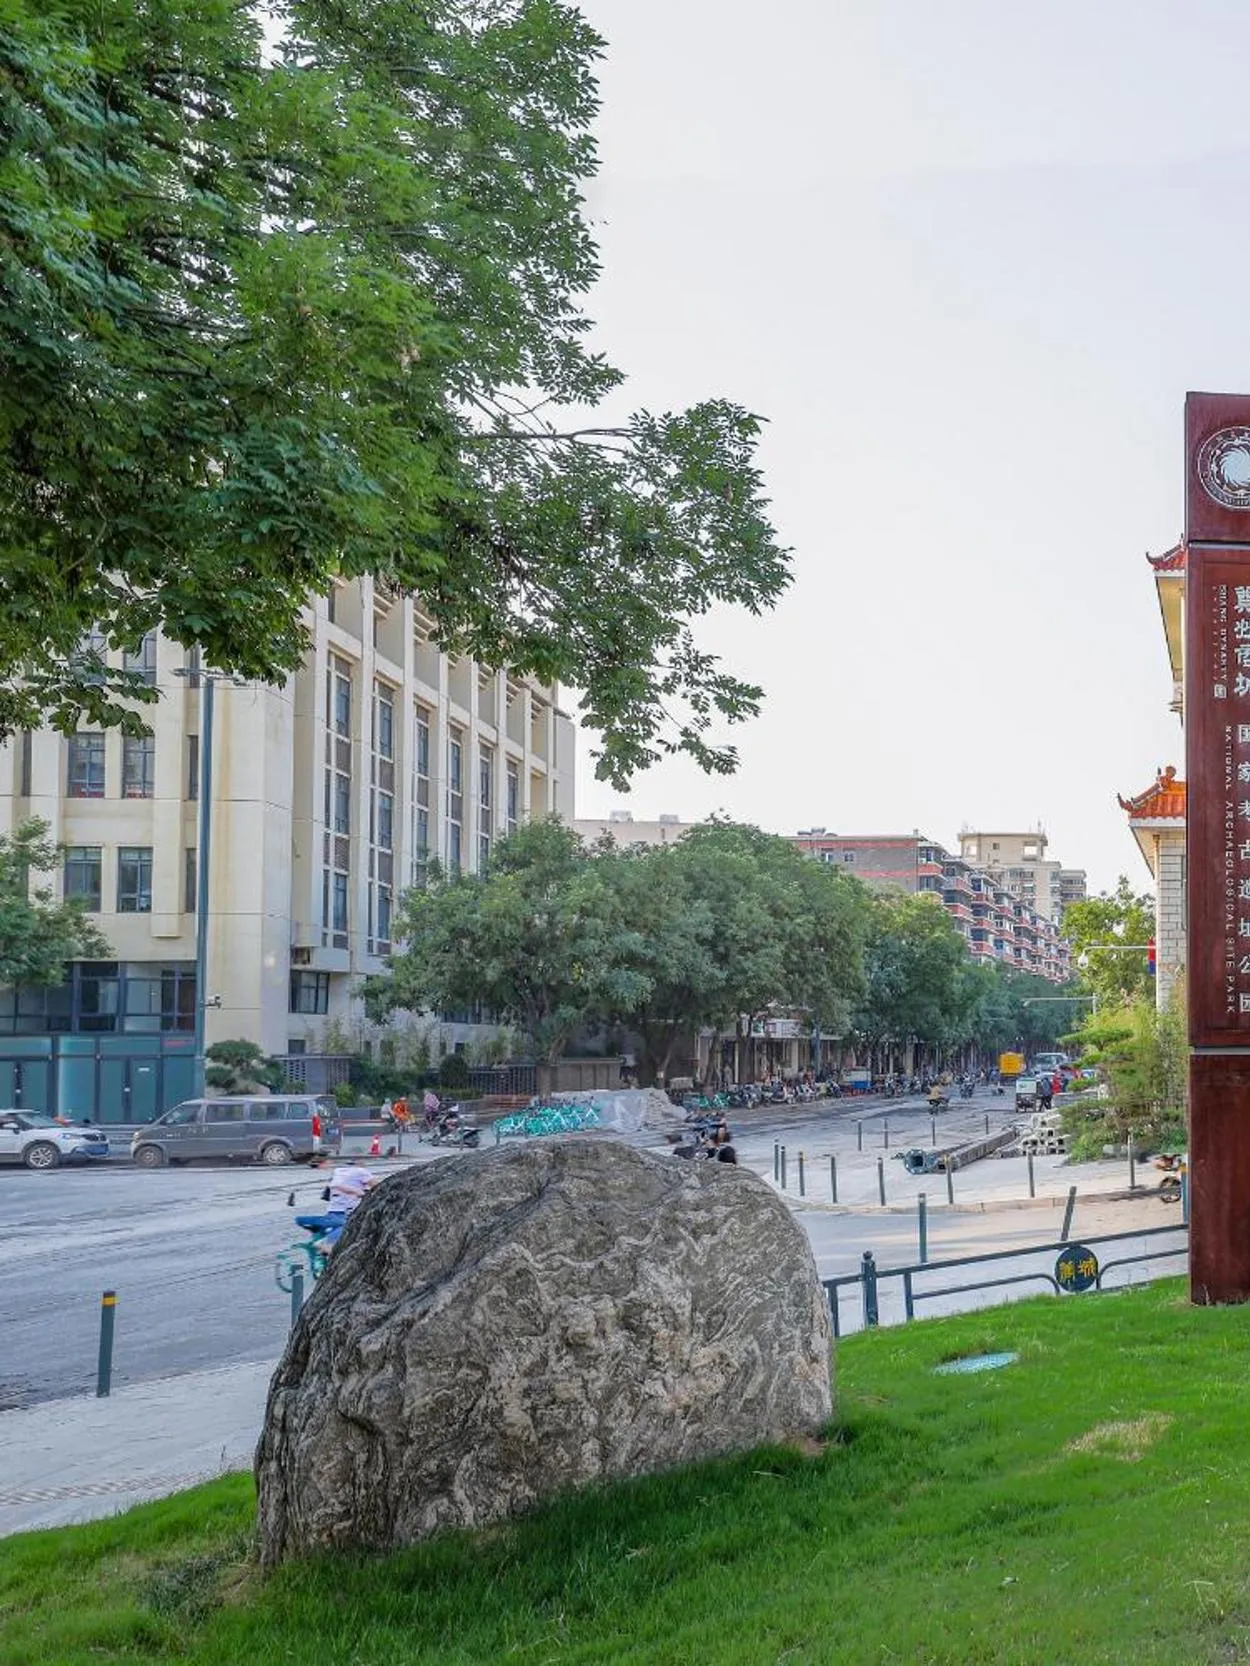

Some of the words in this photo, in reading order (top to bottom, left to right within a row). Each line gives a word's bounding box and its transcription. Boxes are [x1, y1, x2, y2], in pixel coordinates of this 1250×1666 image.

[1225, 725, 1233, 791] NATIONAL
[1225, 800, 1235, 930] ARCHAEOLOGICAL
[1225, 937, 1235, 968] SITE
[1226, 975, 1236, 1013] PARK
